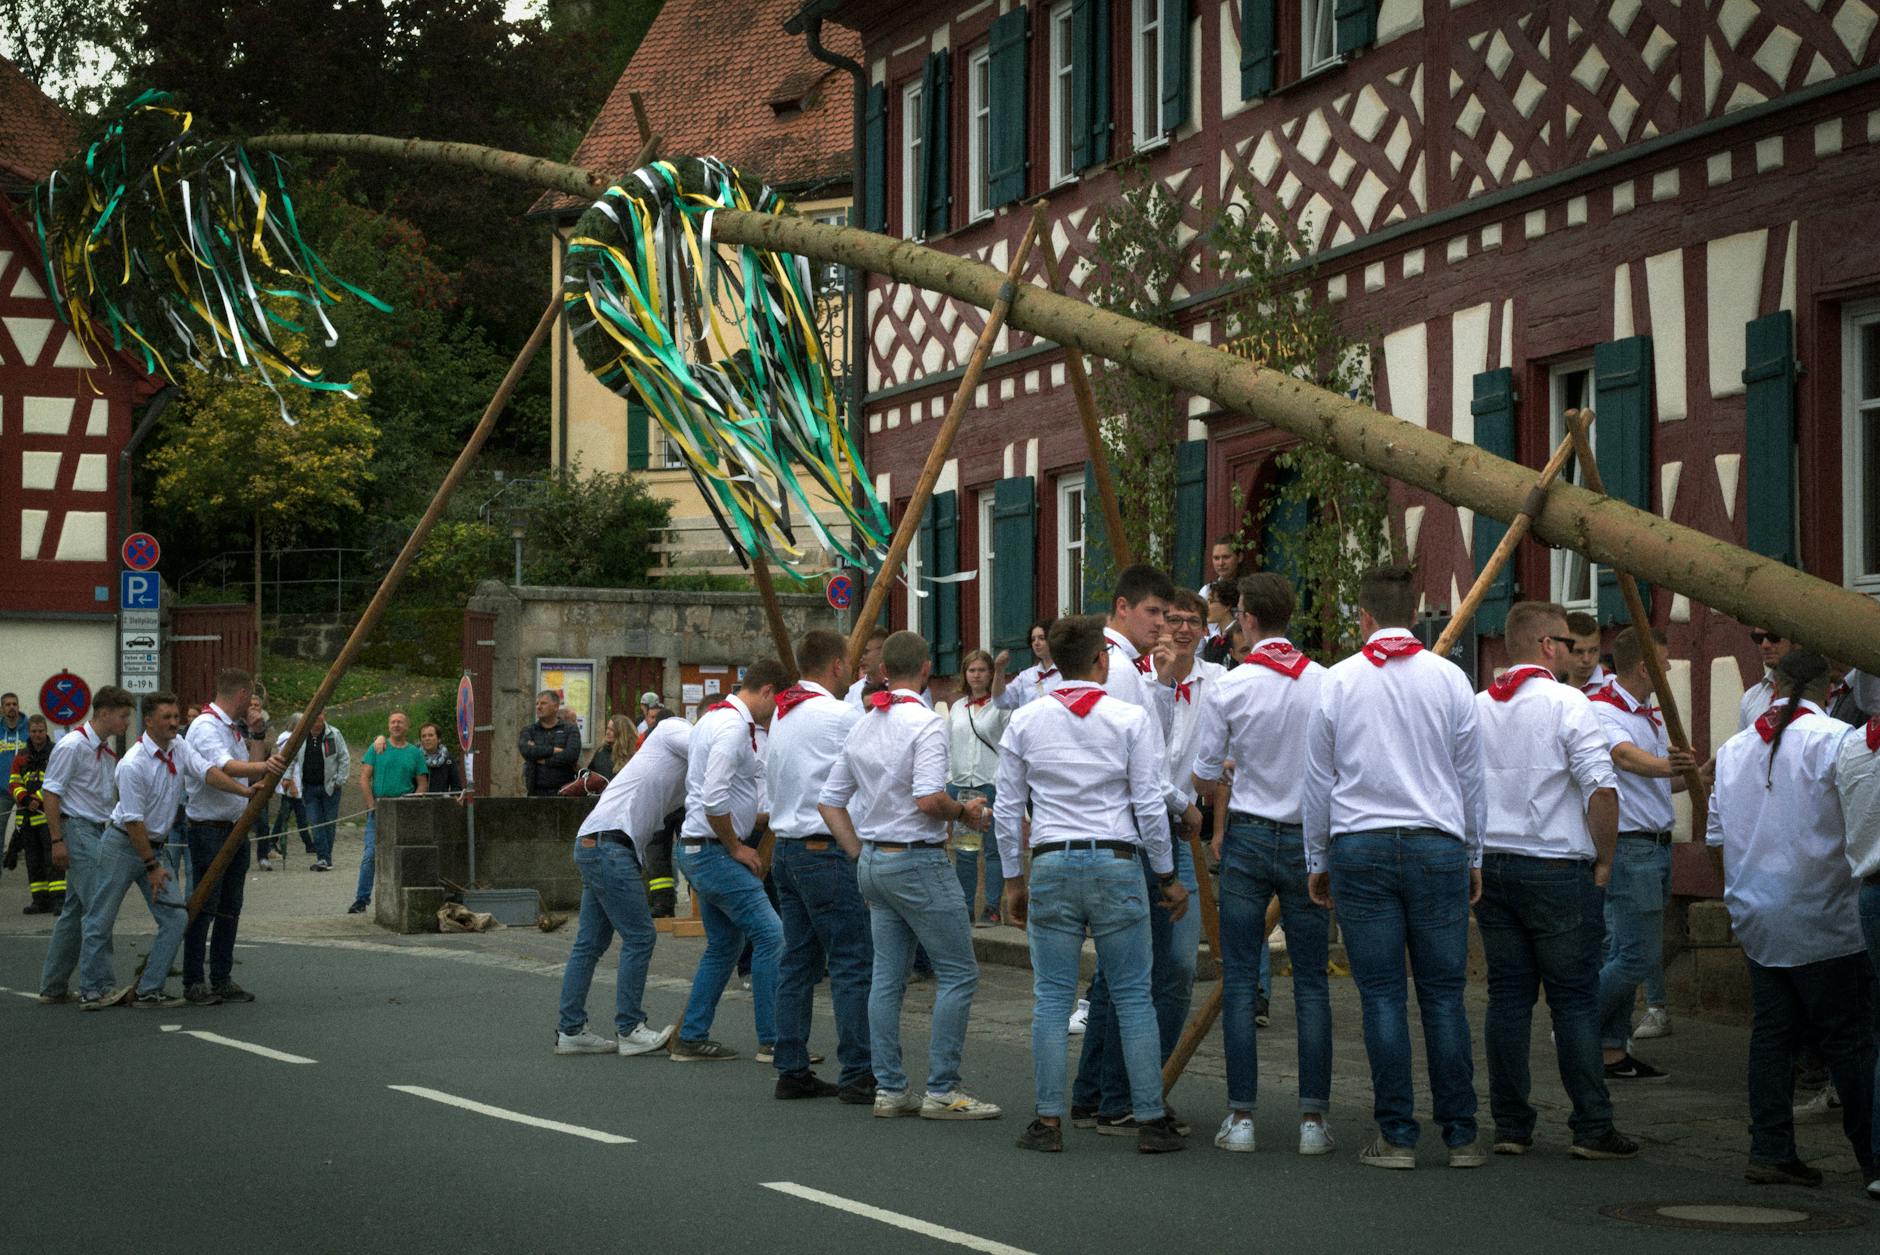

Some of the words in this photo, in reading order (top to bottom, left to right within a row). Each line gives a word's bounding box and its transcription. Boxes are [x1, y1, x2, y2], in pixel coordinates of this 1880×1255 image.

[128, 576, 148, 604] P
[127, 680, 146, 689] 8-19
[148, 680, 153, 689] h
